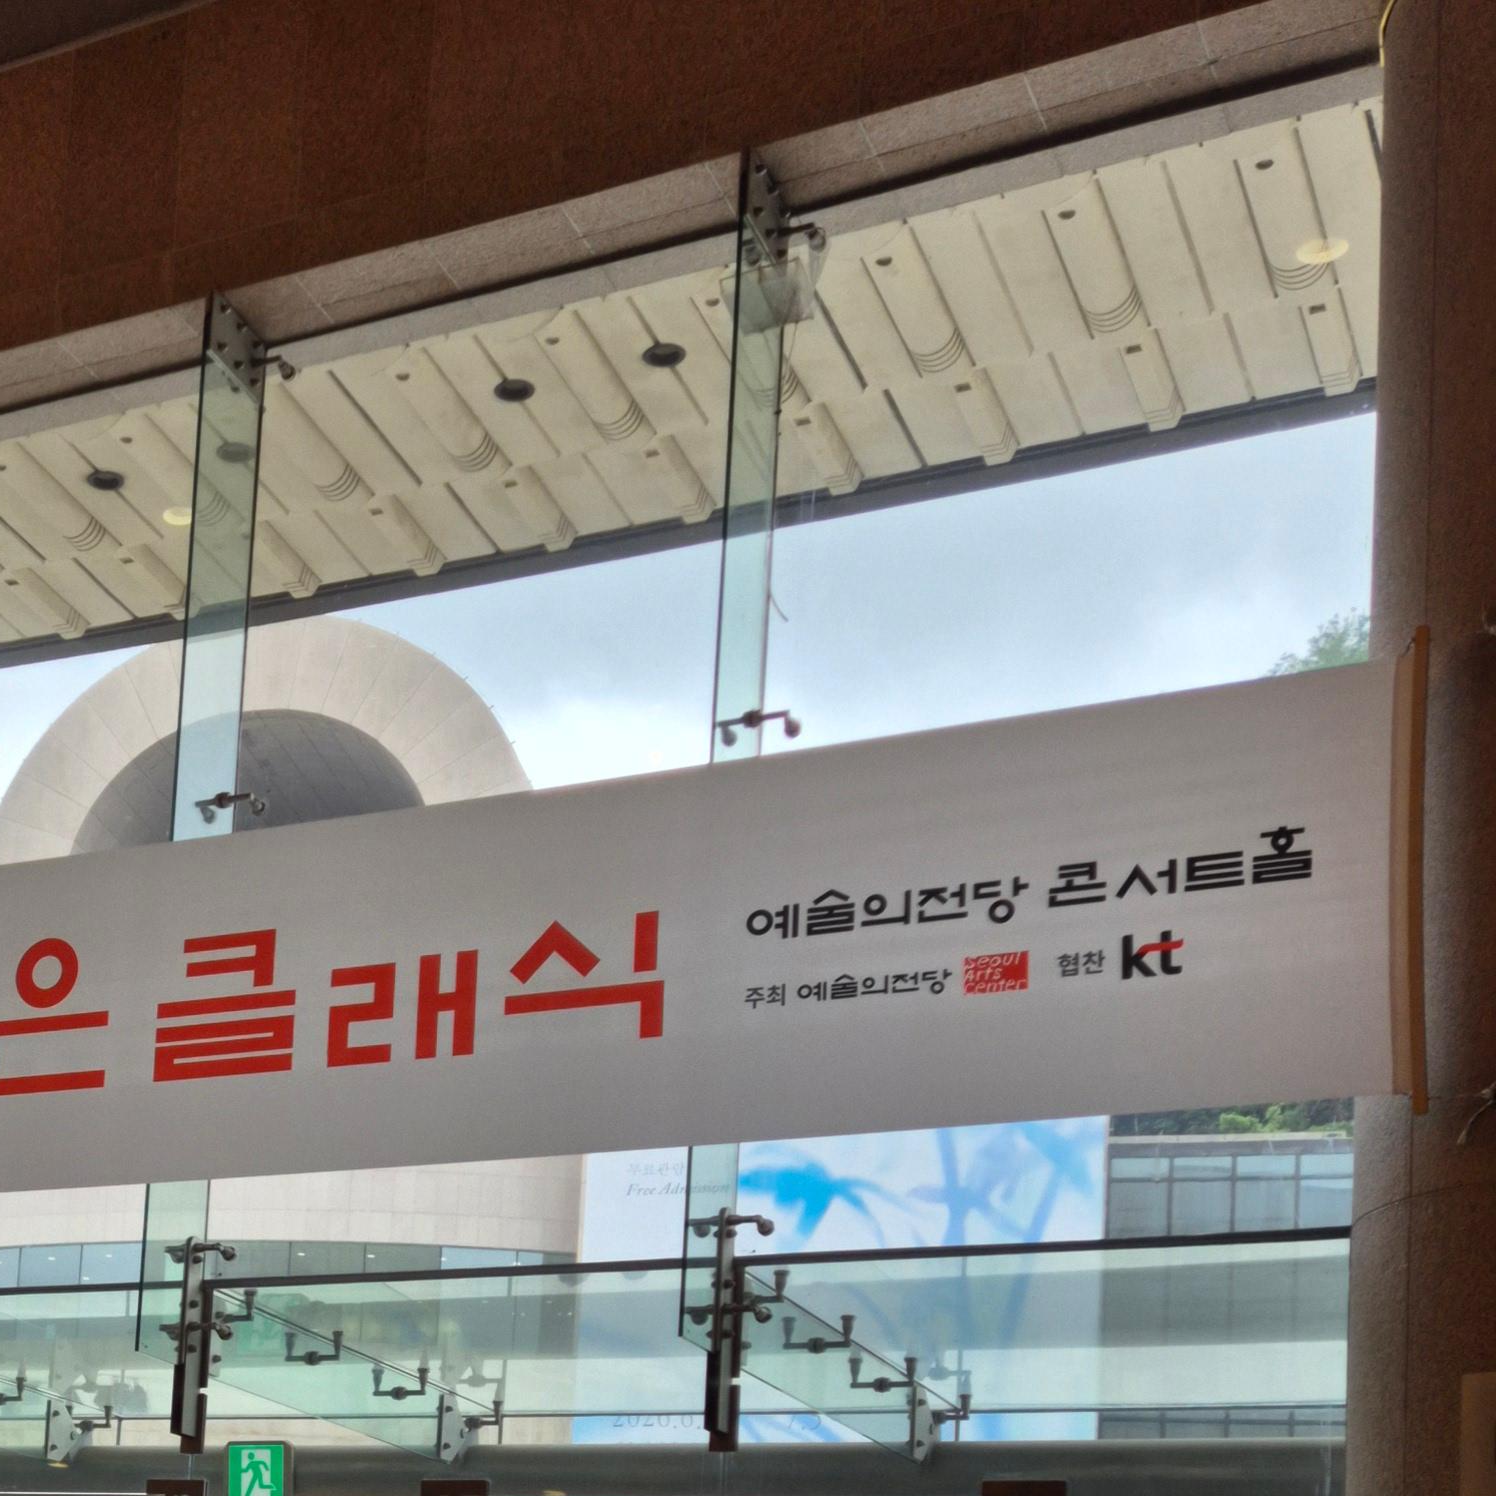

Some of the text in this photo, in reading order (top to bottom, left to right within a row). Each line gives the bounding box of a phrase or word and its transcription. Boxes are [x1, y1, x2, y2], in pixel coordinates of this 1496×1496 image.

[747, 826, 1313, 939] 예술의전당 콘서트홀
[964, 967, 1003, 982] Arts
[1058, 930, 1184, 980] 협찬 kt
[153, 911, 665, 1083] 클래식
[745, 969, 952, 1009] 주최 예술의전당
